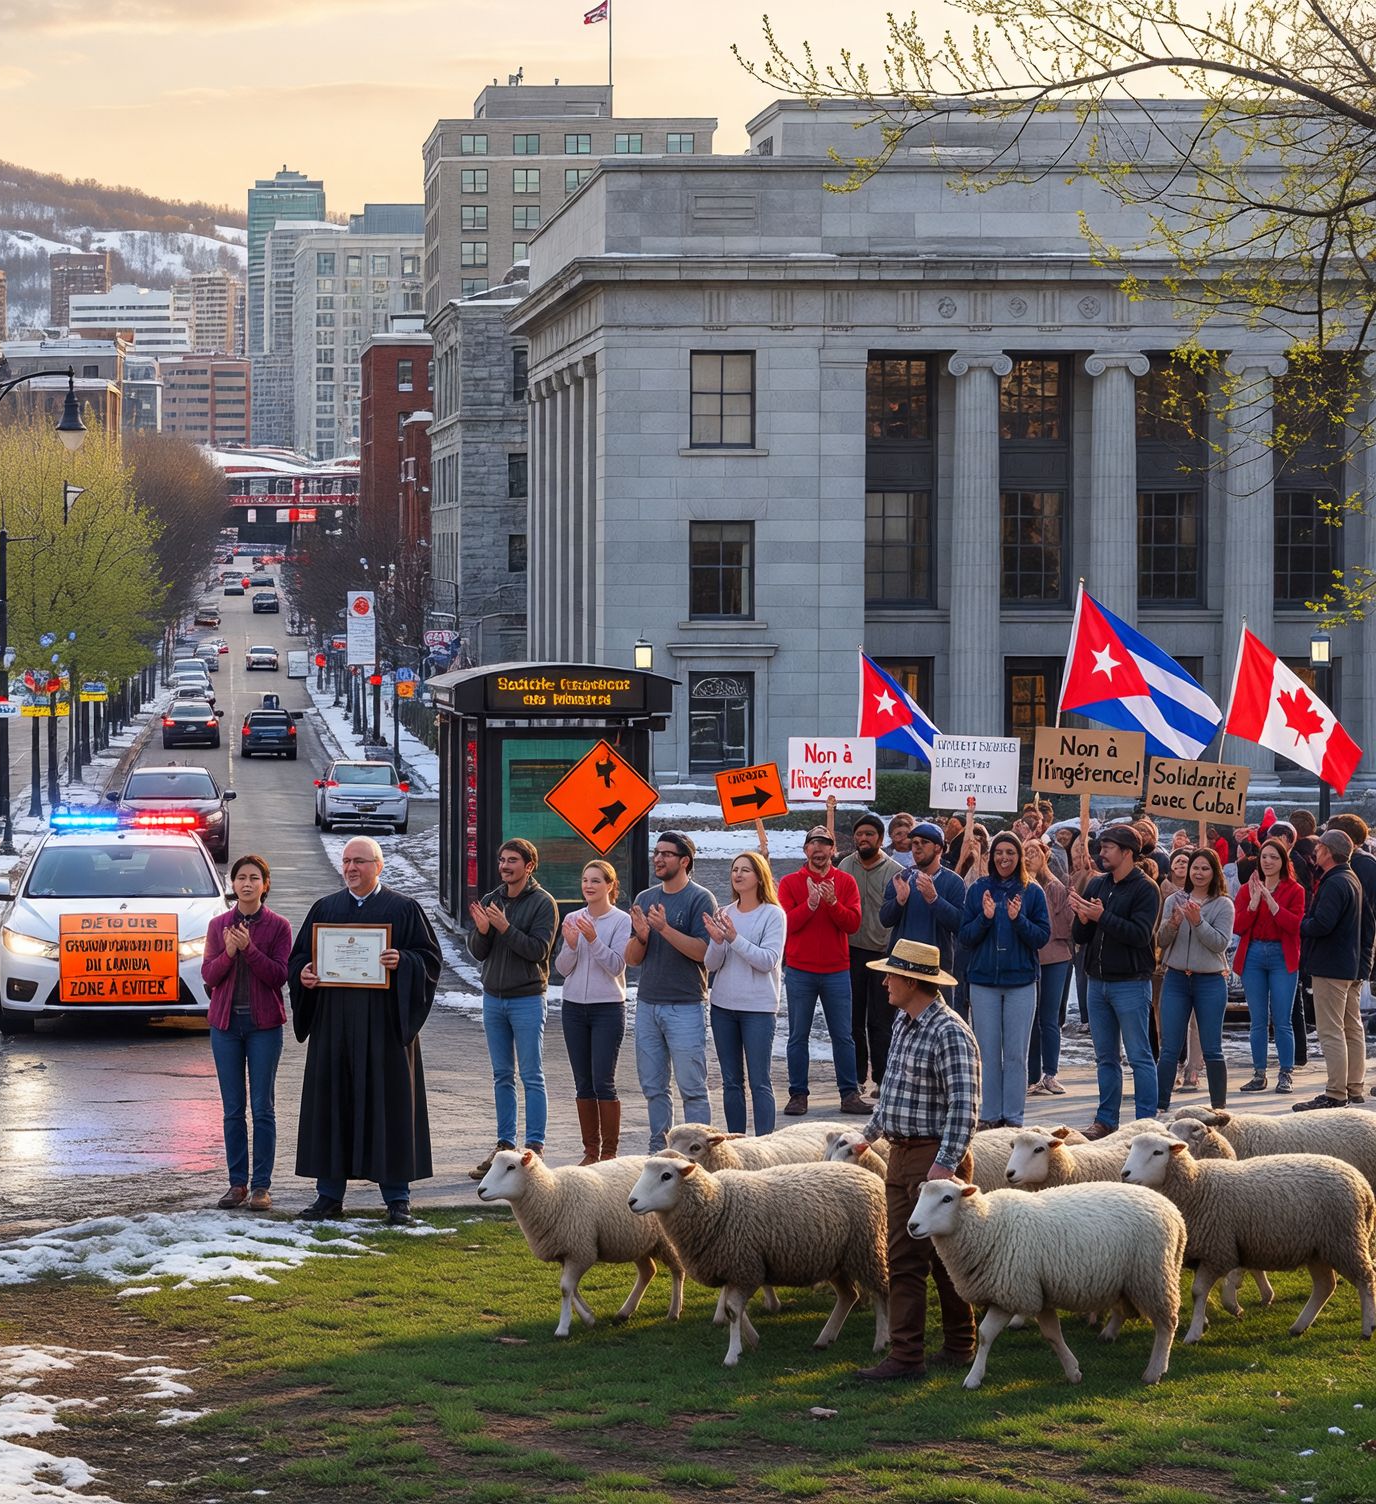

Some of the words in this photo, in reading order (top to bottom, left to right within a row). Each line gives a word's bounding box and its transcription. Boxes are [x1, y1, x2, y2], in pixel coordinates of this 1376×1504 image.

[804, 742, 838, 764] Non
[842, 744, 854, 764] à
[1059, 735, 1099, 758] Non
[1106, 738, 1118, 758] à
[1151, 794, 1187, 810] avec
[70, 981, 106, 997] ZONE
